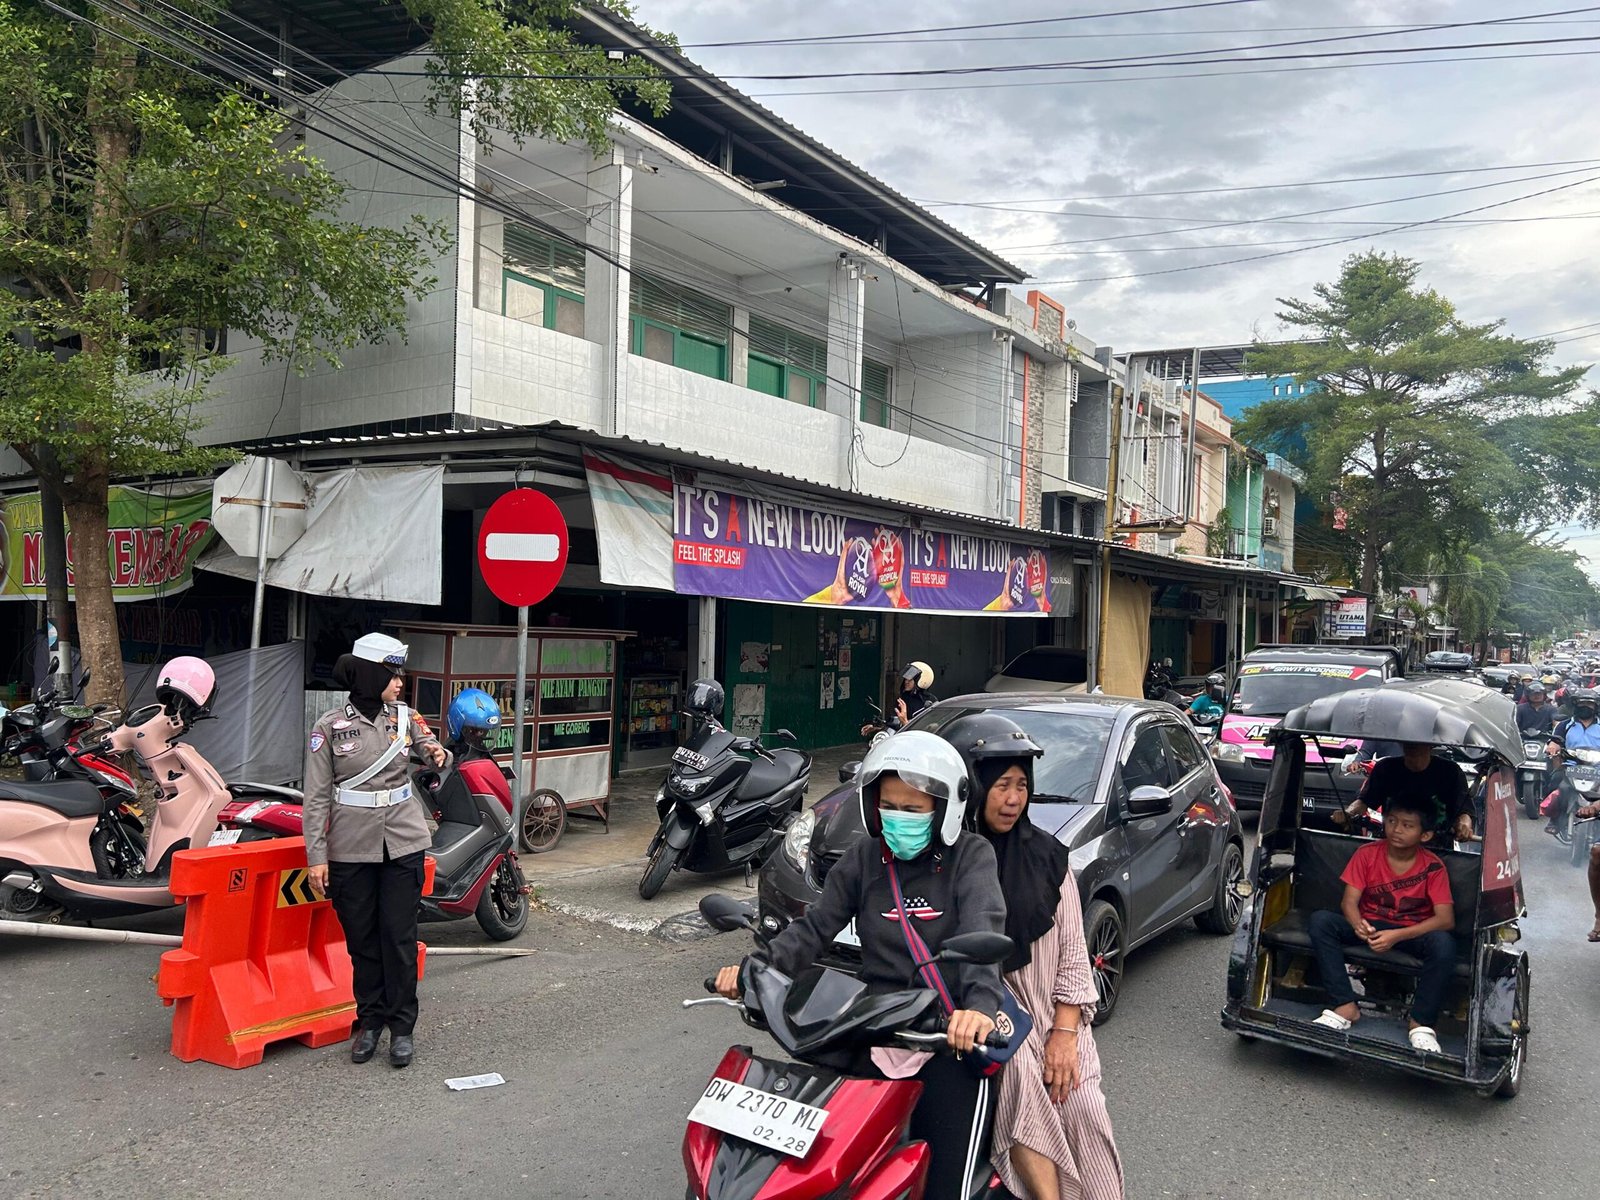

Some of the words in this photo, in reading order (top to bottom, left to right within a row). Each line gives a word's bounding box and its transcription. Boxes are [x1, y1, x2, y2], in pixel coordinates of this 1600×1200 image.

[673, 484, 719, 539] IT'S
[725, 496, 742, 543] A
[747, 499, 793, 549] NEW
[800, 509, 848, 557] LOOK
[678, 544, 697, 561] FEEL
[698, 546, 712, 563] THE
[714, 547, 741, 565] SPLASH
[909, 528, 934, 567] IT'S
[936, 533, 948, 568] A
[950, 534, 978, 572] NEW
[982, 539, 1011, 573] LOOK
[848, 577, 868, 598] ROYAL
[879, 572, 898, 584] TROPICAL
[911, 571, 921, 582] FEEL
[922, 572, 930, 584] THE
[931, 573, 946, 585] SPLASH
[541, 680, 554, 698] MIE
[555, 680, 574, 698] AYAM
[578, 679, 608, 697] PANGSIT
[332, 730, 361, 741] FITRI
[554, 723, 565, 736] MIE
[565, 721, 590, 735] GORENG
[1496, 861, 1511, 879] 24
[704, 1080, 735, 1102] DW
[736, 1090, 788, 1119] 2370
[792, 1106, 821, 1132] ML
